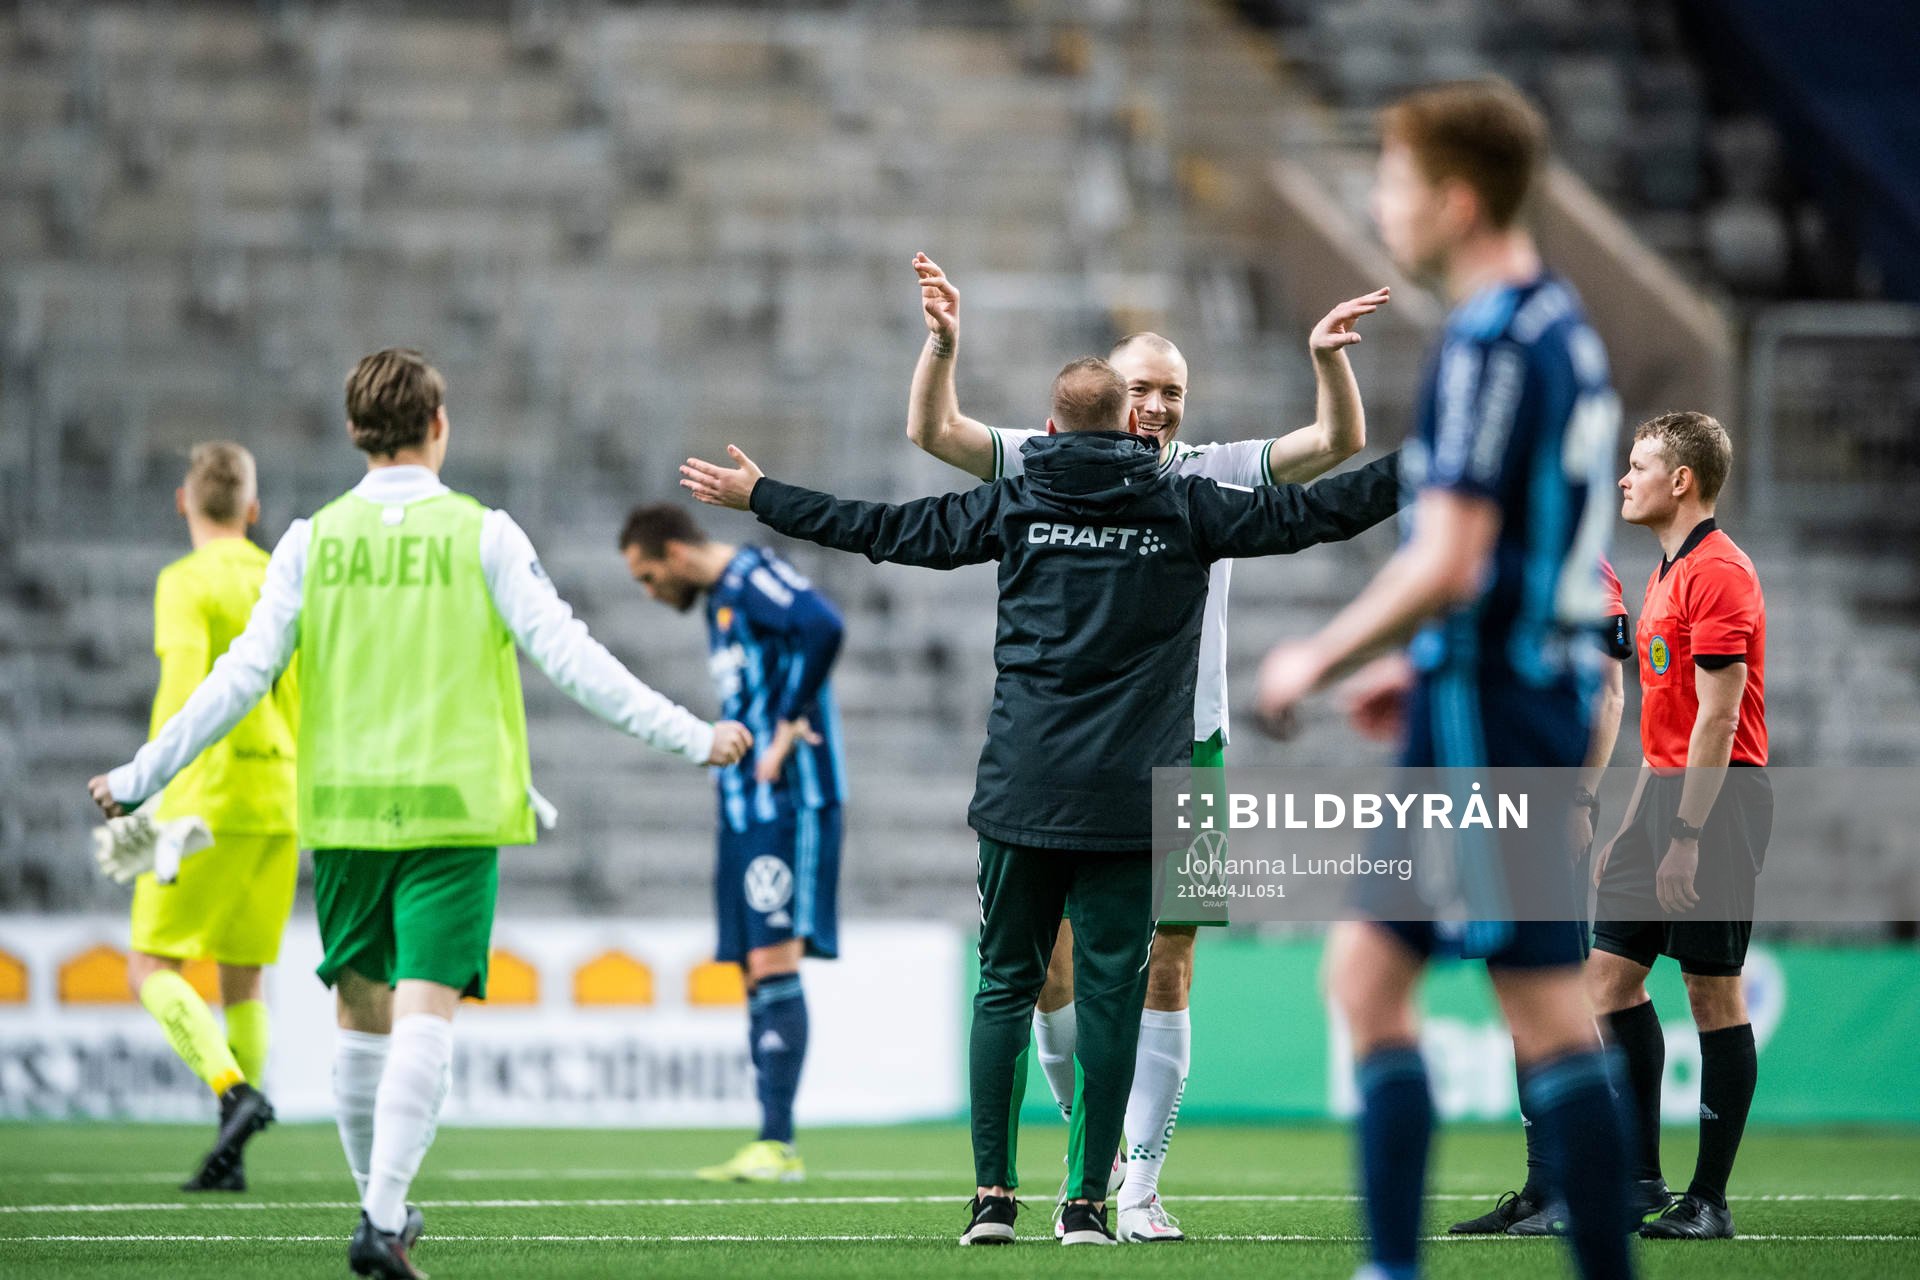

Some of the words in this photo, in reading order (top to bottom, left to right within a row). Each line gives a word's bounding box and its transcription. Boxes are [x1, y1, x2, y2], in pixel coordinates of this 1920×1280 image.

[1028, 522, 1139, 550] CRAFT
[318, 534, 453, 588] BAJEN
[1201, 900, 1229, 908] CRAFT
